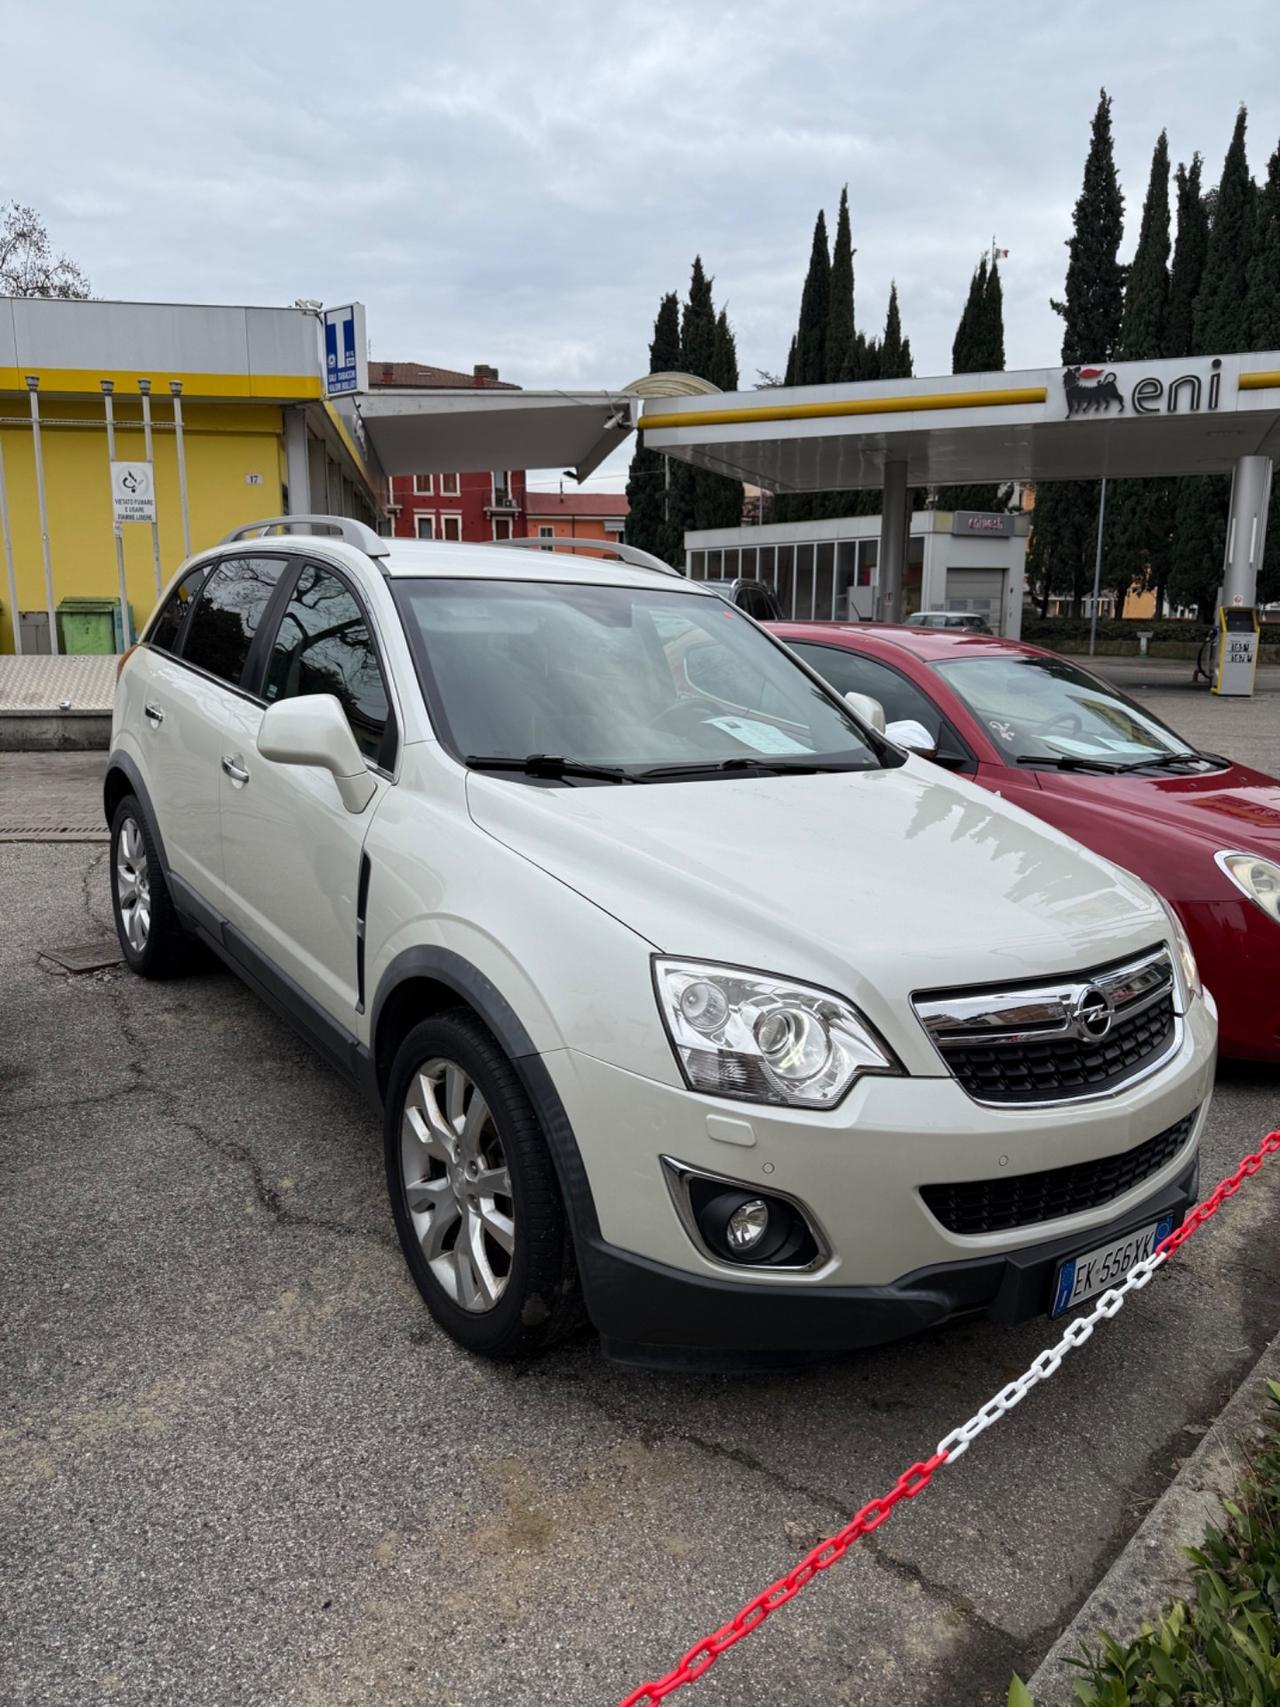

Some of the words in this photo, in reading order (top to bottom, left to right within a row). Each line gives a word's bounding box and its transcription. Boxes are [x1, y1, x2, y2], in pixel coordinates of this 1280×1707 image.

[325, 306, 352, 369] T
[1132, 358, 1222, 415] eni
[250, 475, 258, 484] 17
[1073, 1259, 1097, 1297] EK
[1099, 1231, 1154, 1283] 556XK
